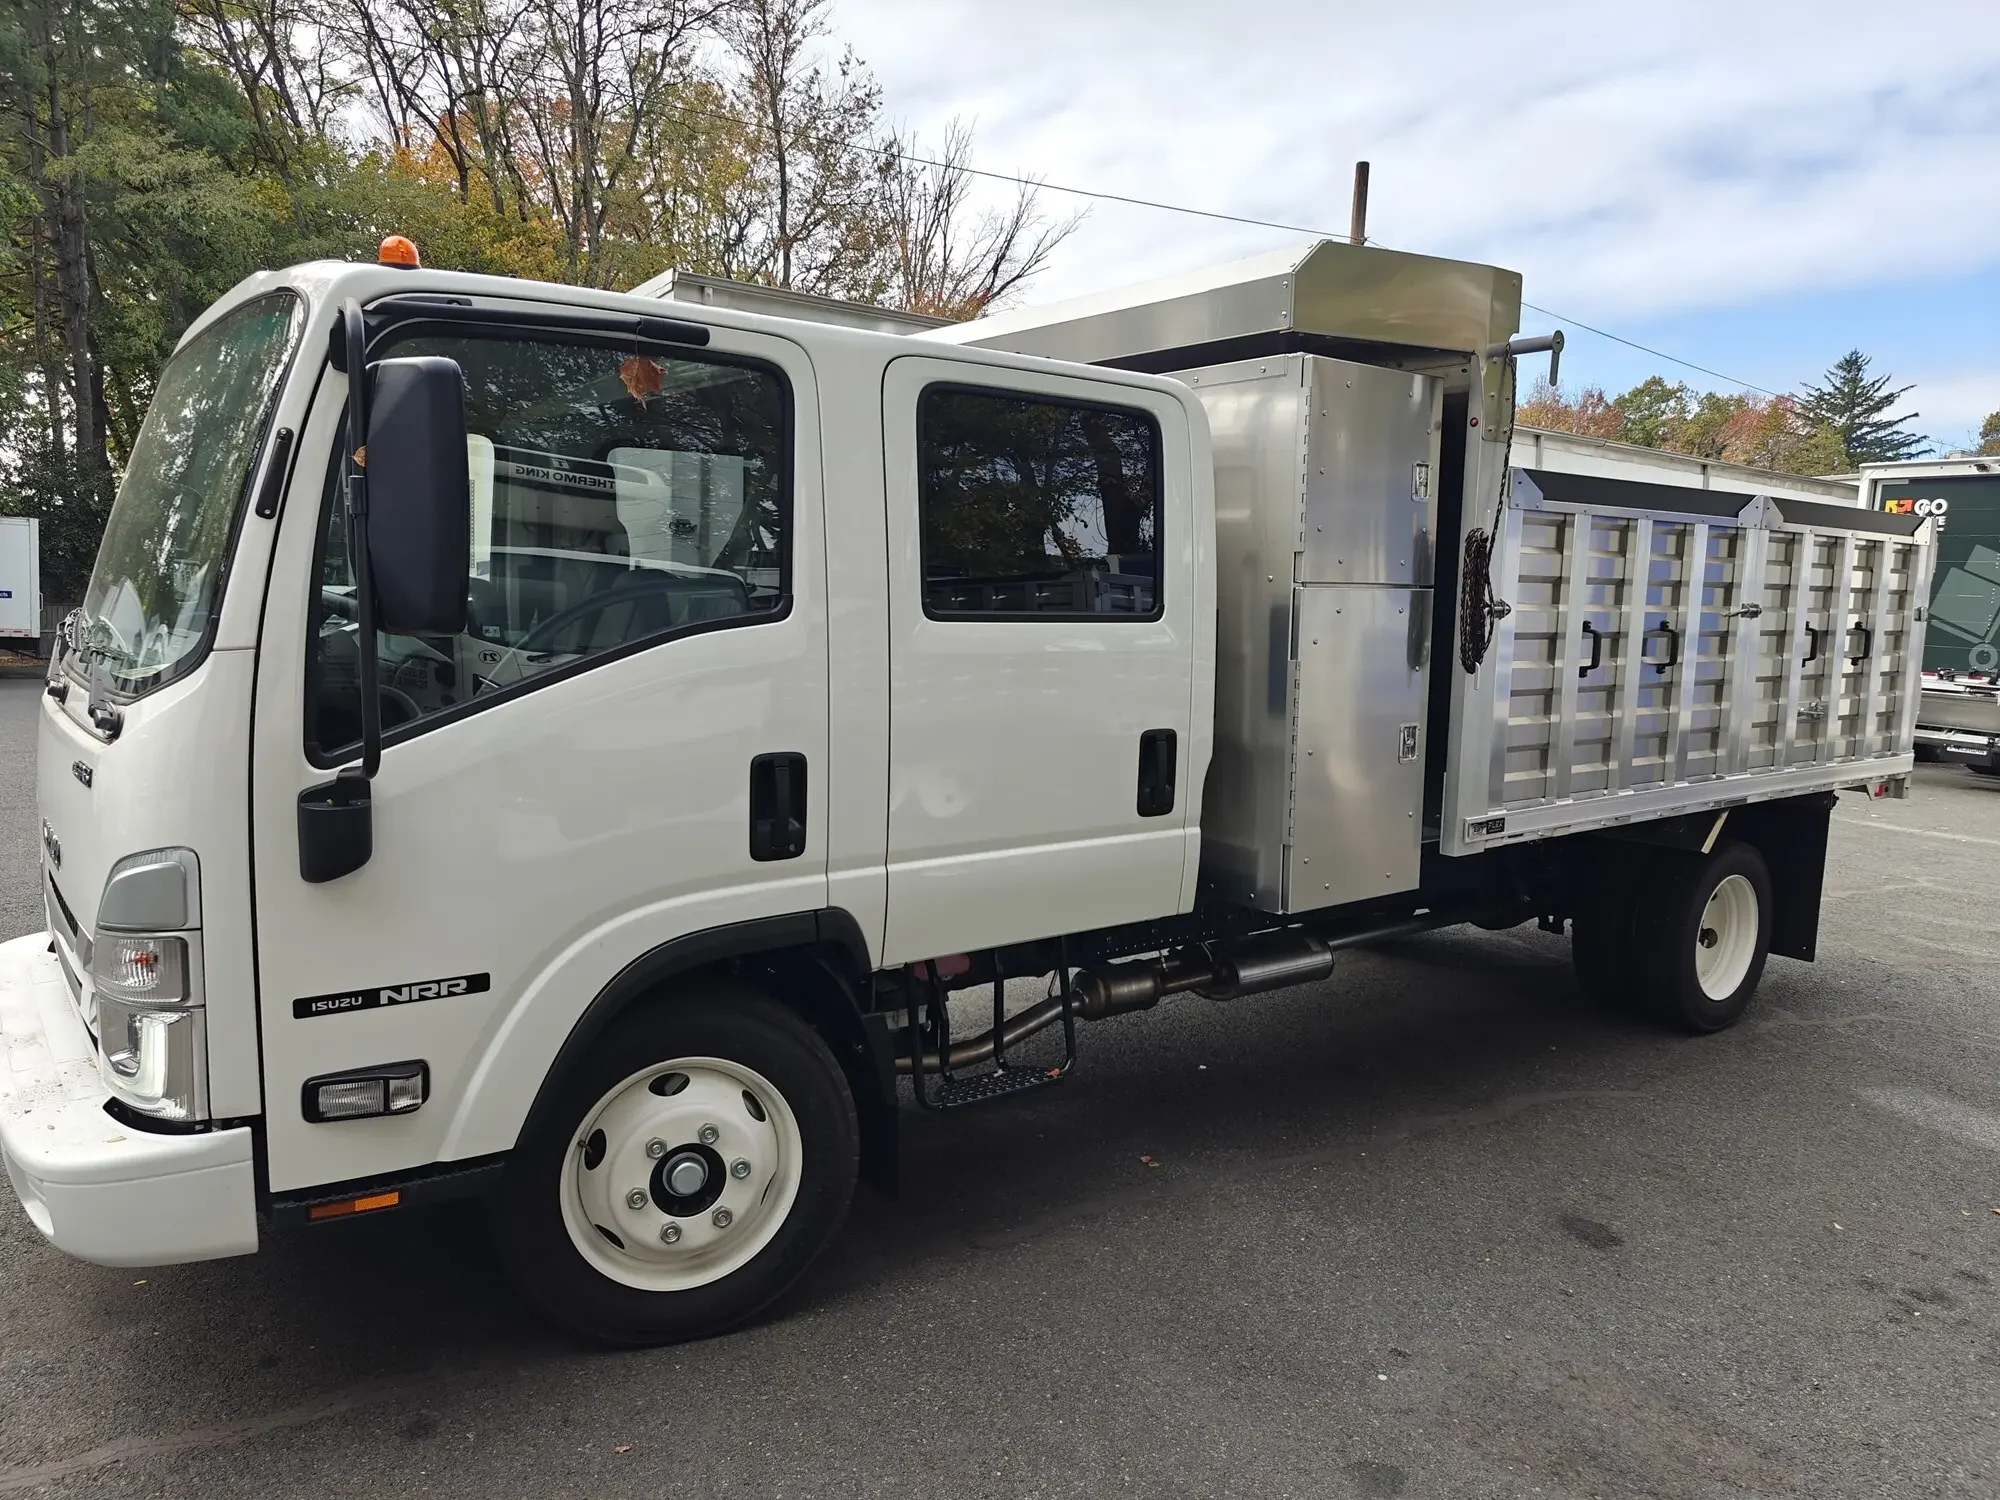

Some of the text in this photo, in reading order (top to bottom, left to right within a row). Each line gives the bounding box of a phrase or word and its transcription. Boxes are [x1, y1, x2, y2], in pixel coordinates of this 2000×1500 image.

[1914, 498, 1948, 516] GO
[311, 978, 468, 1012] ISUZU NRR
